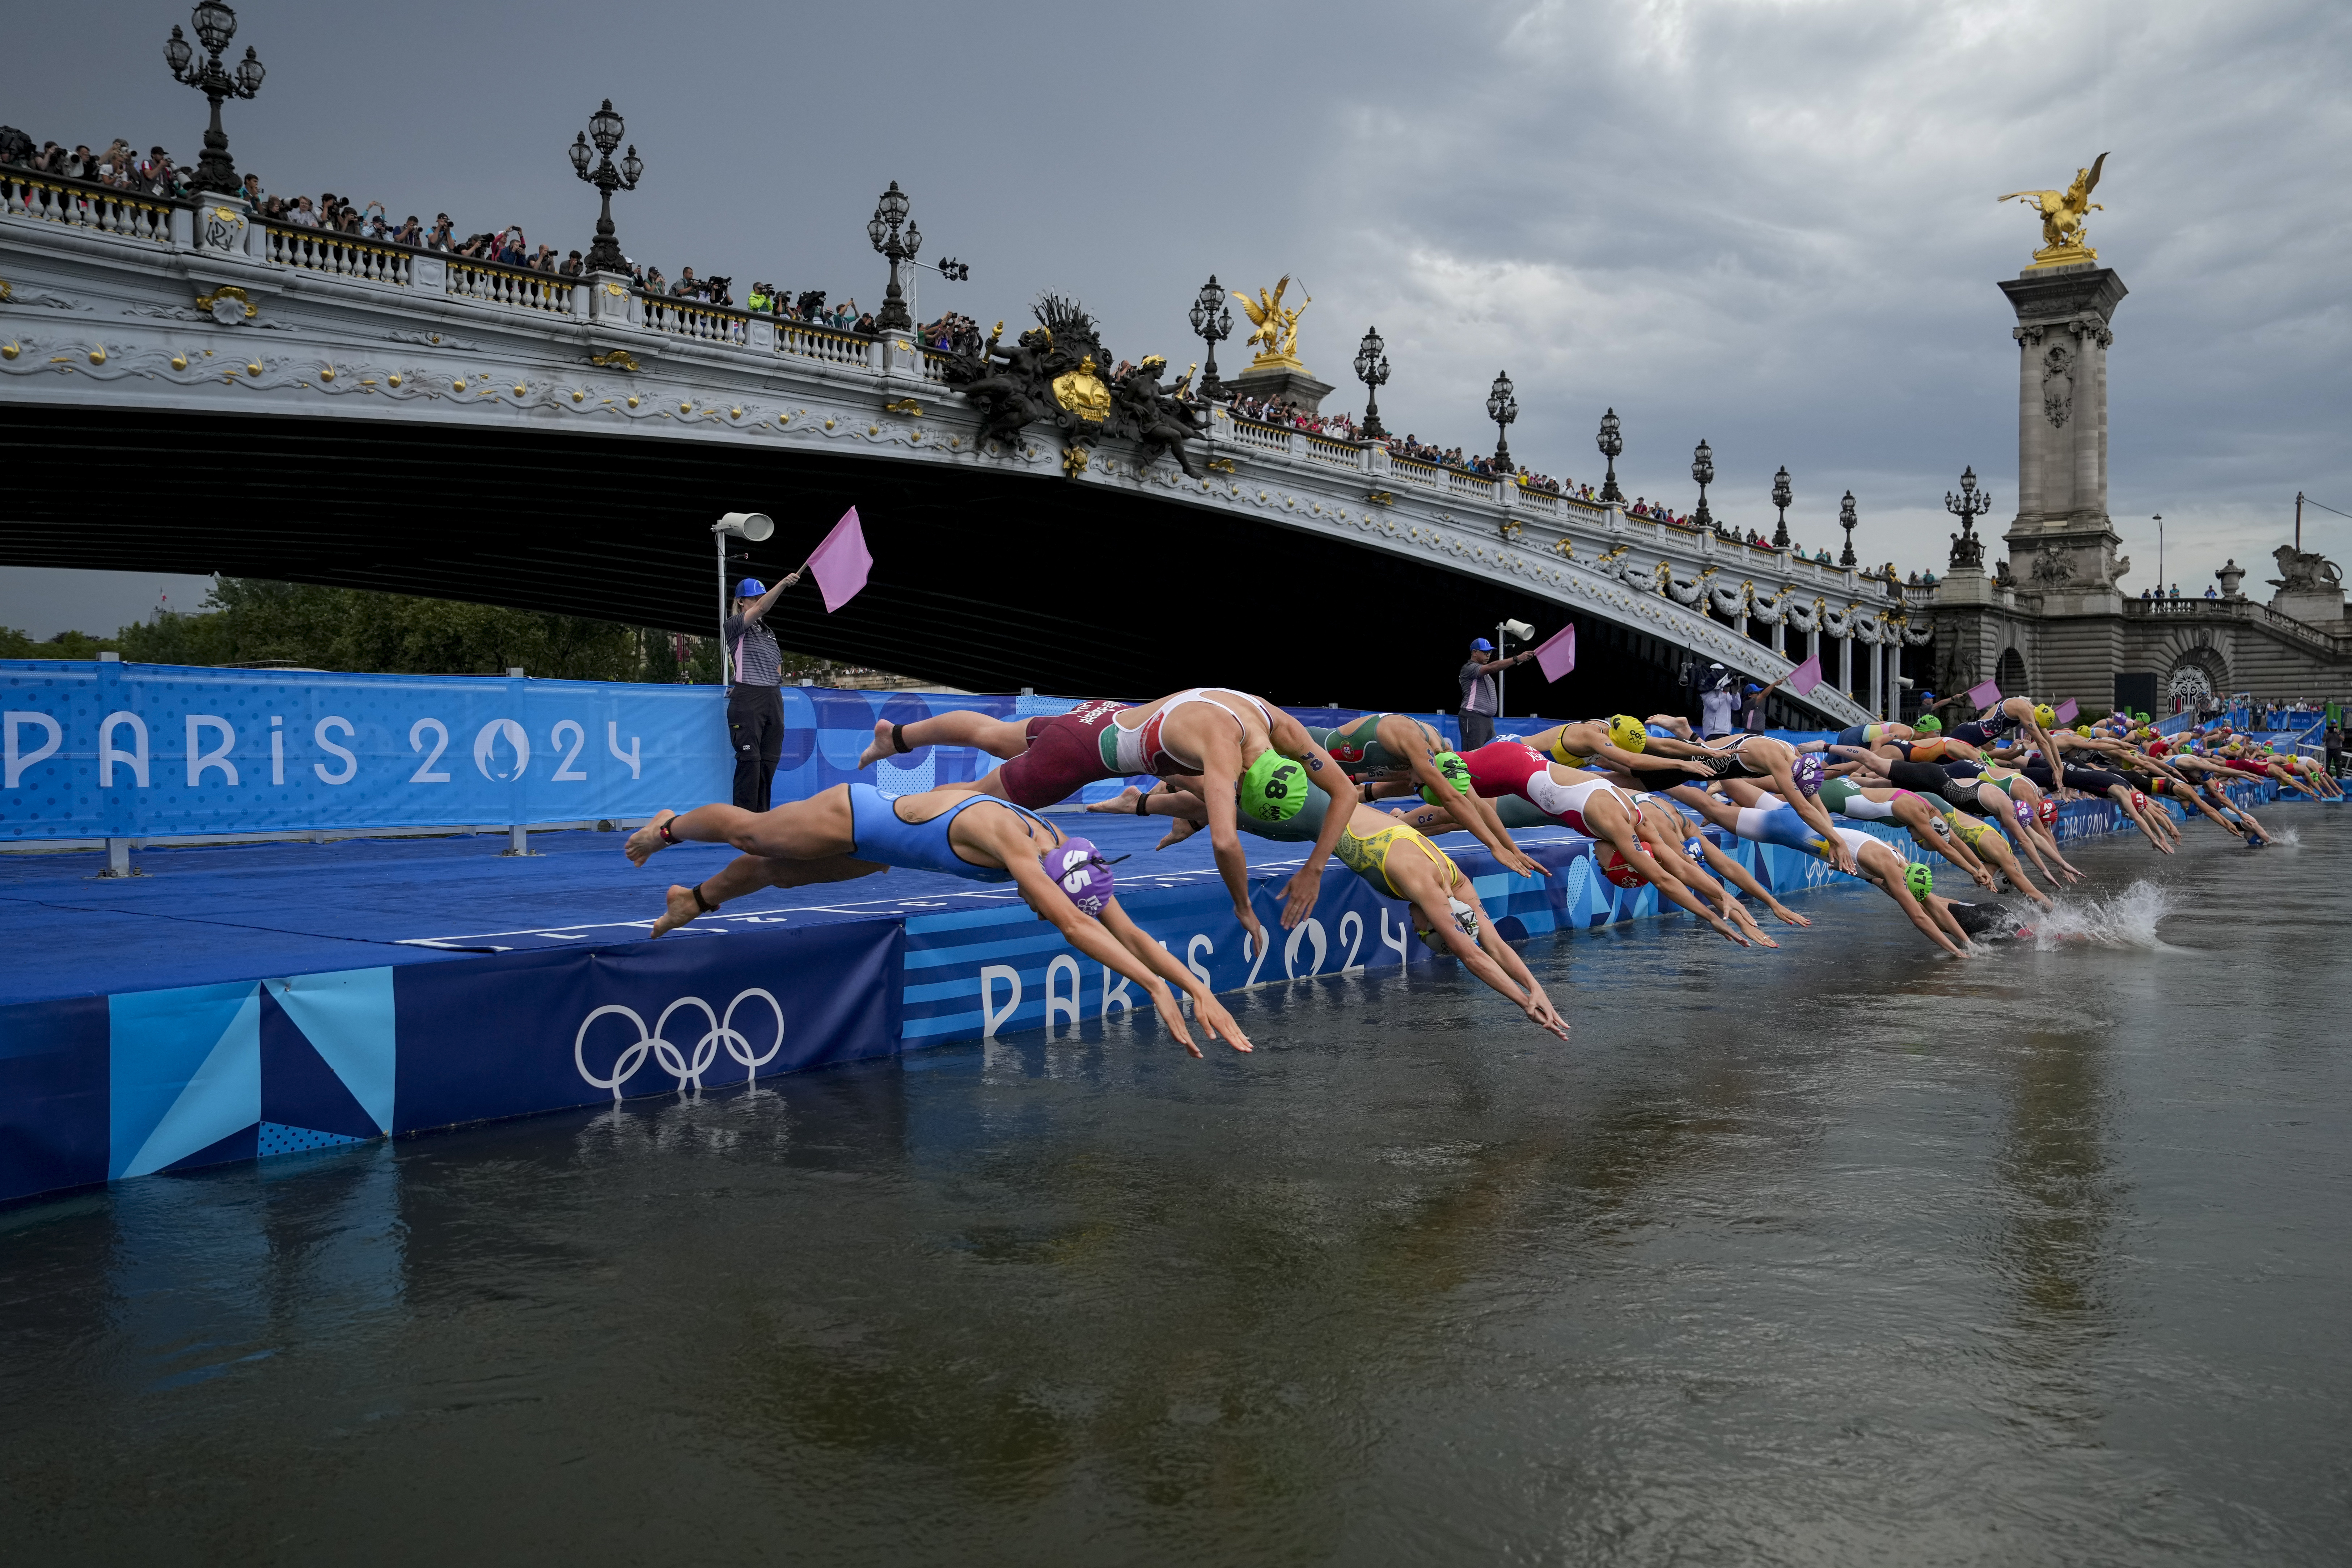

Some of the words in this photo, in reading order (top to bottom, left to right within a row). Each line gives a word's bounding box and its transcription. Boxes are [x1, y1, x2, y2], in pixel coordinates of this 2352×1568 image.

[409, 717, 640, 783] 2024
[1300, 750, 1324, 772] 48
[1802, 757, 1817, 781] 53
[1265, 765, 1298, 799] 48
[2136, 793, 2144, 803] 27
[1418, 813, 1434, 824] 40
[2017, 801, 2028, 816] 52
[1632, 834, 1643, 852] 28
[1063, 850, 1092, 894] 55
[1914, 868, 1928, 886] 47
[1450, 911, 1466, 931] 14
